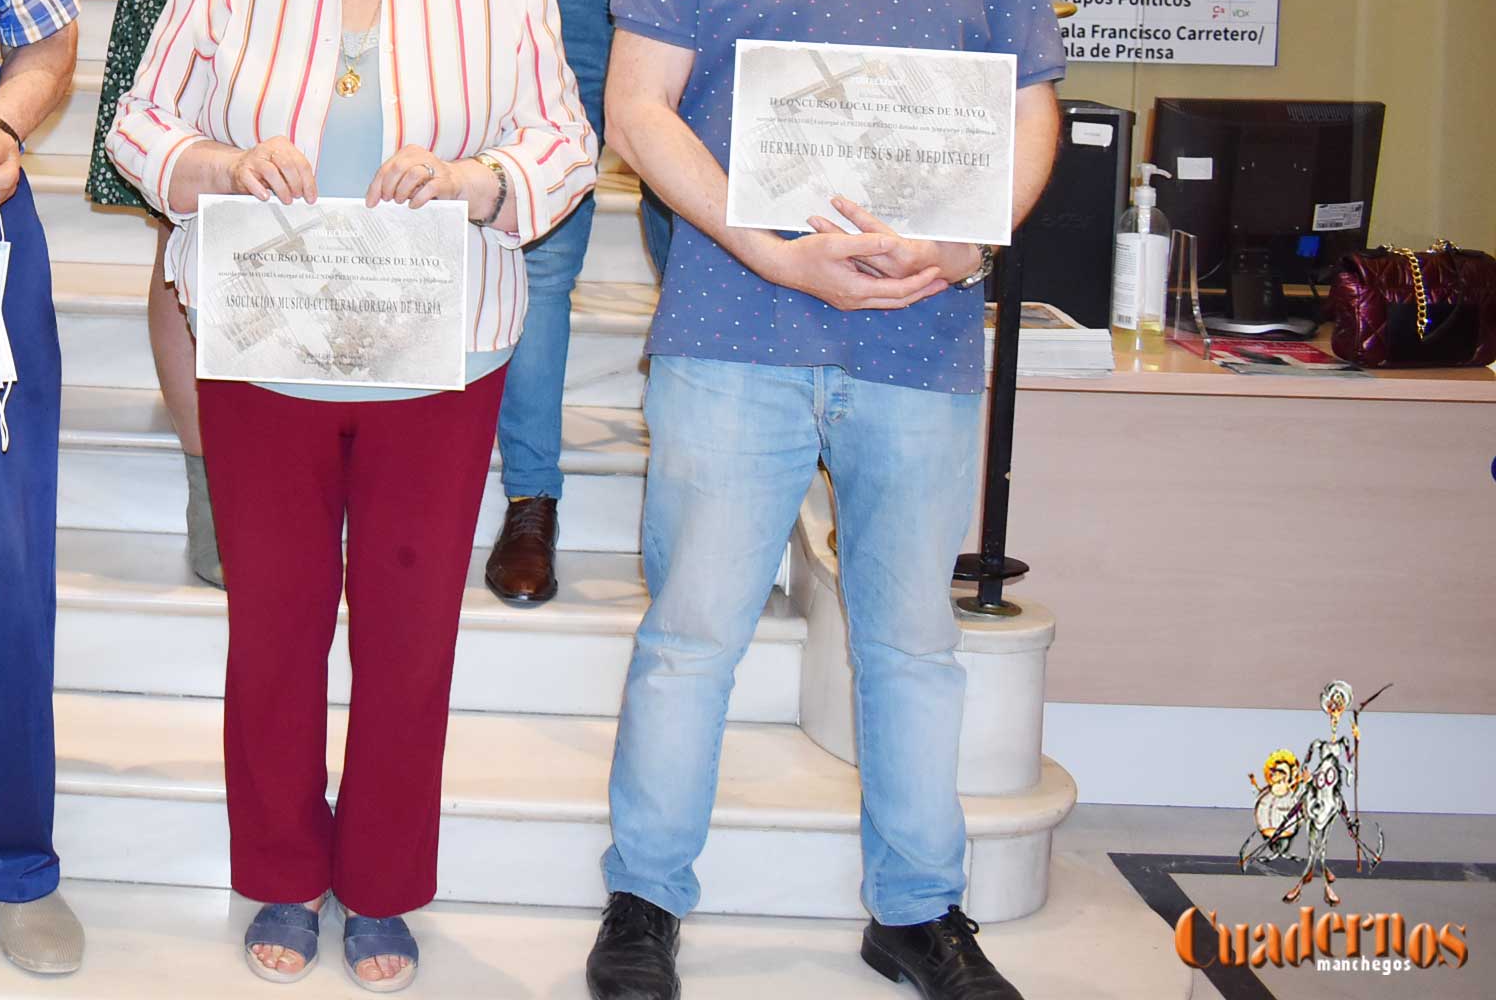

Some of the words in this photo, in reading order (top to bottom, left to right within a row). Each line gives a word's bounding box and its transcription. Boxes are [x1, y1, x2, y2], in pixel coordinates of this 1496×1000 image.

[1060, 22, 1086, 38] ala
[1090, 23, 1172, 40] Francisco
[1176, 25, 1265, 45] Carretero/
[1090, 42, 1111, 58] de
[1116, 44, 1174, 60] Prensa
[778, 98, 838, 110] CONCURSO
[840, 102, 874, 111] LOCAL
[876, 103, 891, 112] DE
[892, 104, 934, 116] CRUCES
[937, 106, 952, 116] DE
[954, 108, 986, 118] MAYO
[760, 140, 834, 157] HERMANDAD
[838, 145, 853, 158] DE
[894, 148, 912, 162] DE
[915, 148, 990, 167] MEDINACELI
[241, 252, 298, 262] CONCURSO
[300, 254, 332, 264] LOCAL
[336, 256, 349, 264] DE
[350, 256, 390, 266] CRUCES
[393, 257, 406, 266] DE
[409, 258, 440, 268] MAYO
[400, 300, 412, 314] DE
[414, 300, 442, 314] MARÍA
